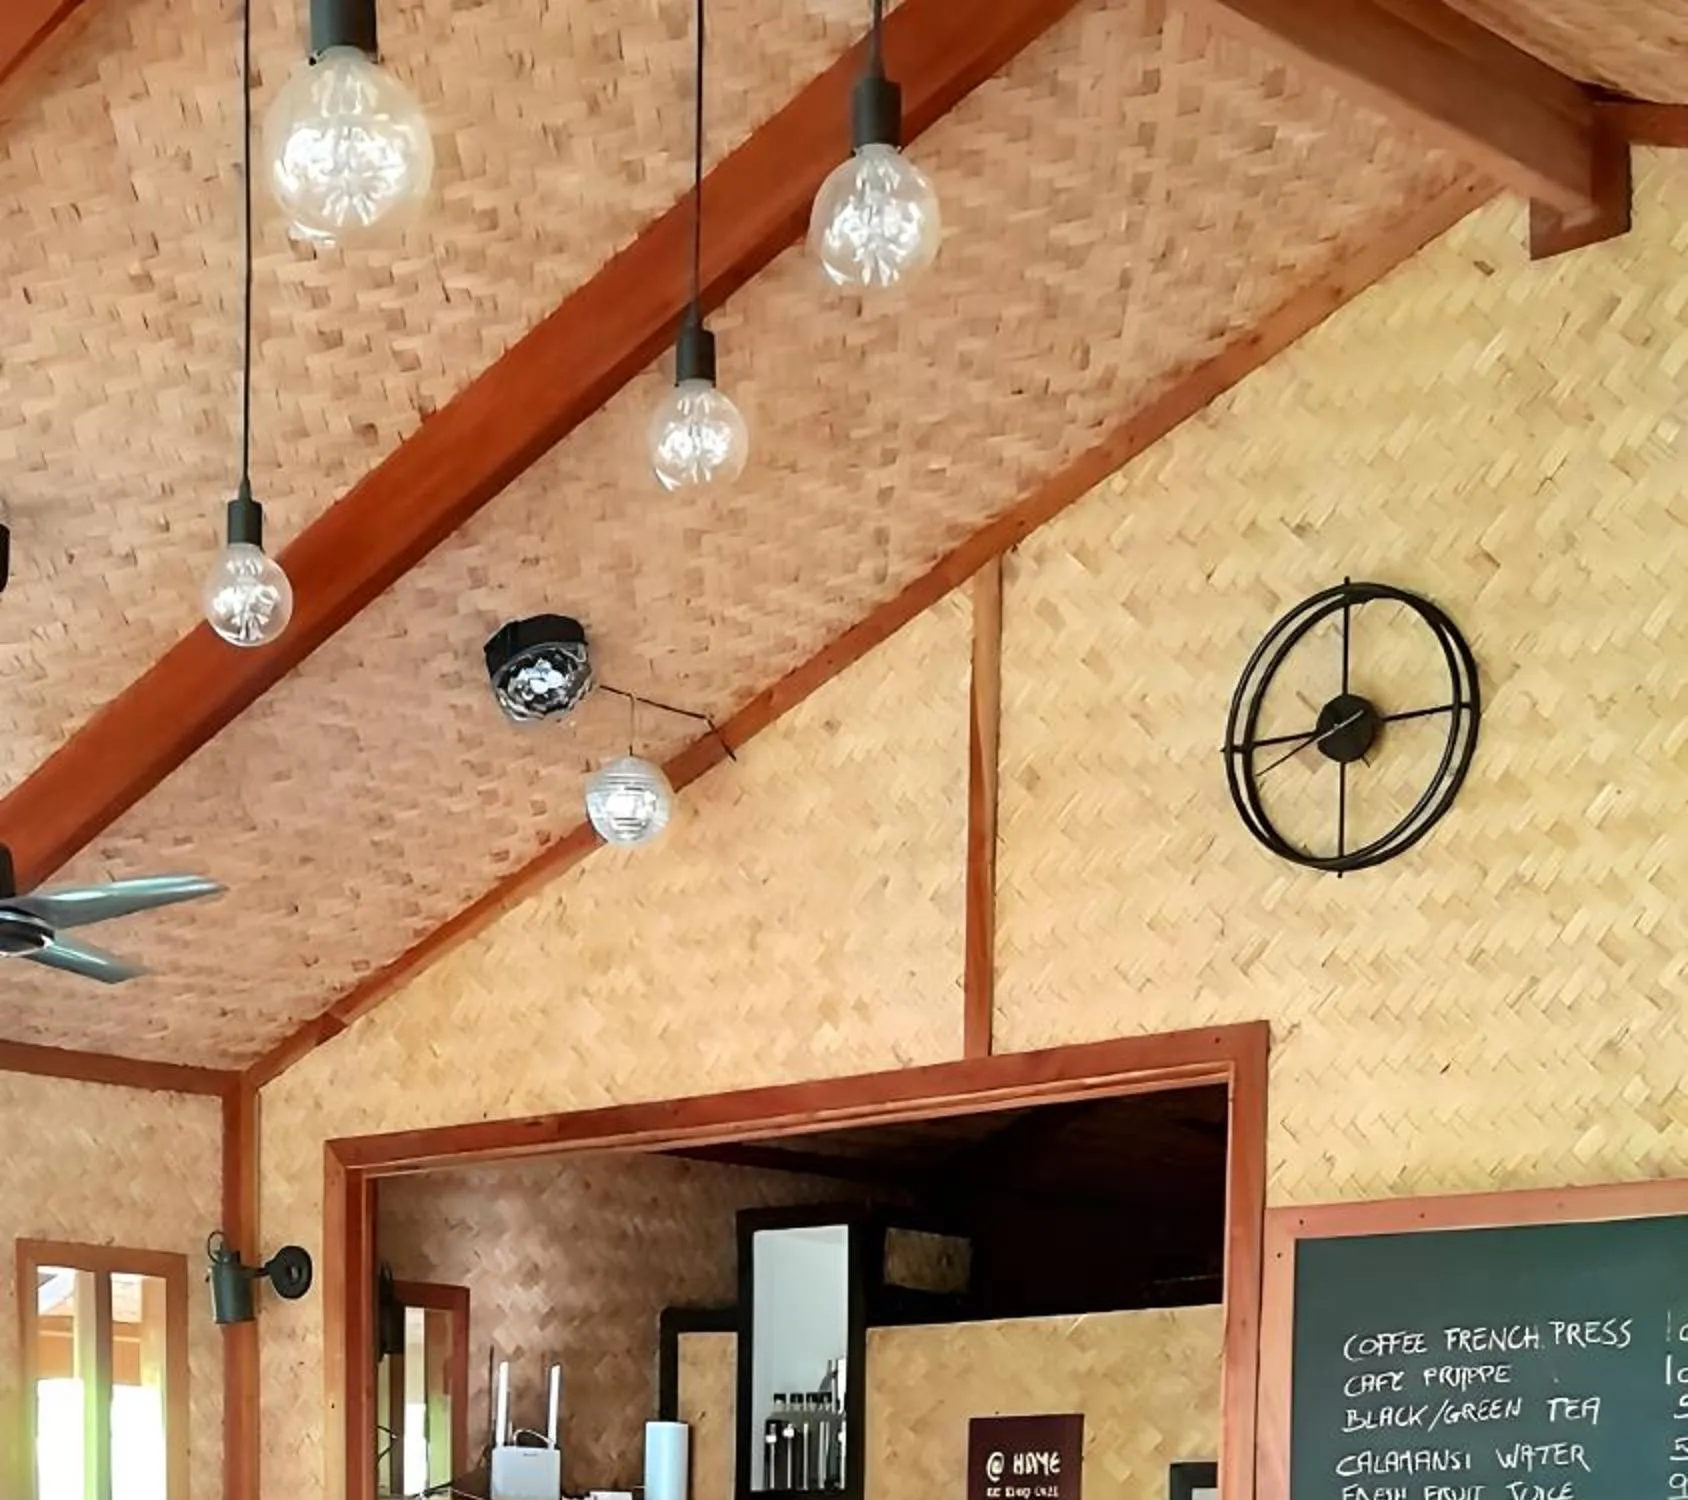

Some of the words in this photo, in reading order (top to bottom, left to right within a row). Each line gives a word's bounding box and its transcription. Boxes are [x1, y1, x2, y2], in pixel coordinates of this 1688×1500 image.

[1344, 1331, 1427, 1362] COFFEE
[1445, 1325, 1539, 1352] FRENCH
[1549, 1318, 1633, 1348] PRESS
[1342, 1397, 1522, 1432] BLACK/GREEN
[1546, 1397, 1601, 1425] TEA
[1336, 1449, 1472, 1476] CALAMANSI
[1496, 1442, 1592, 1472] WATER
